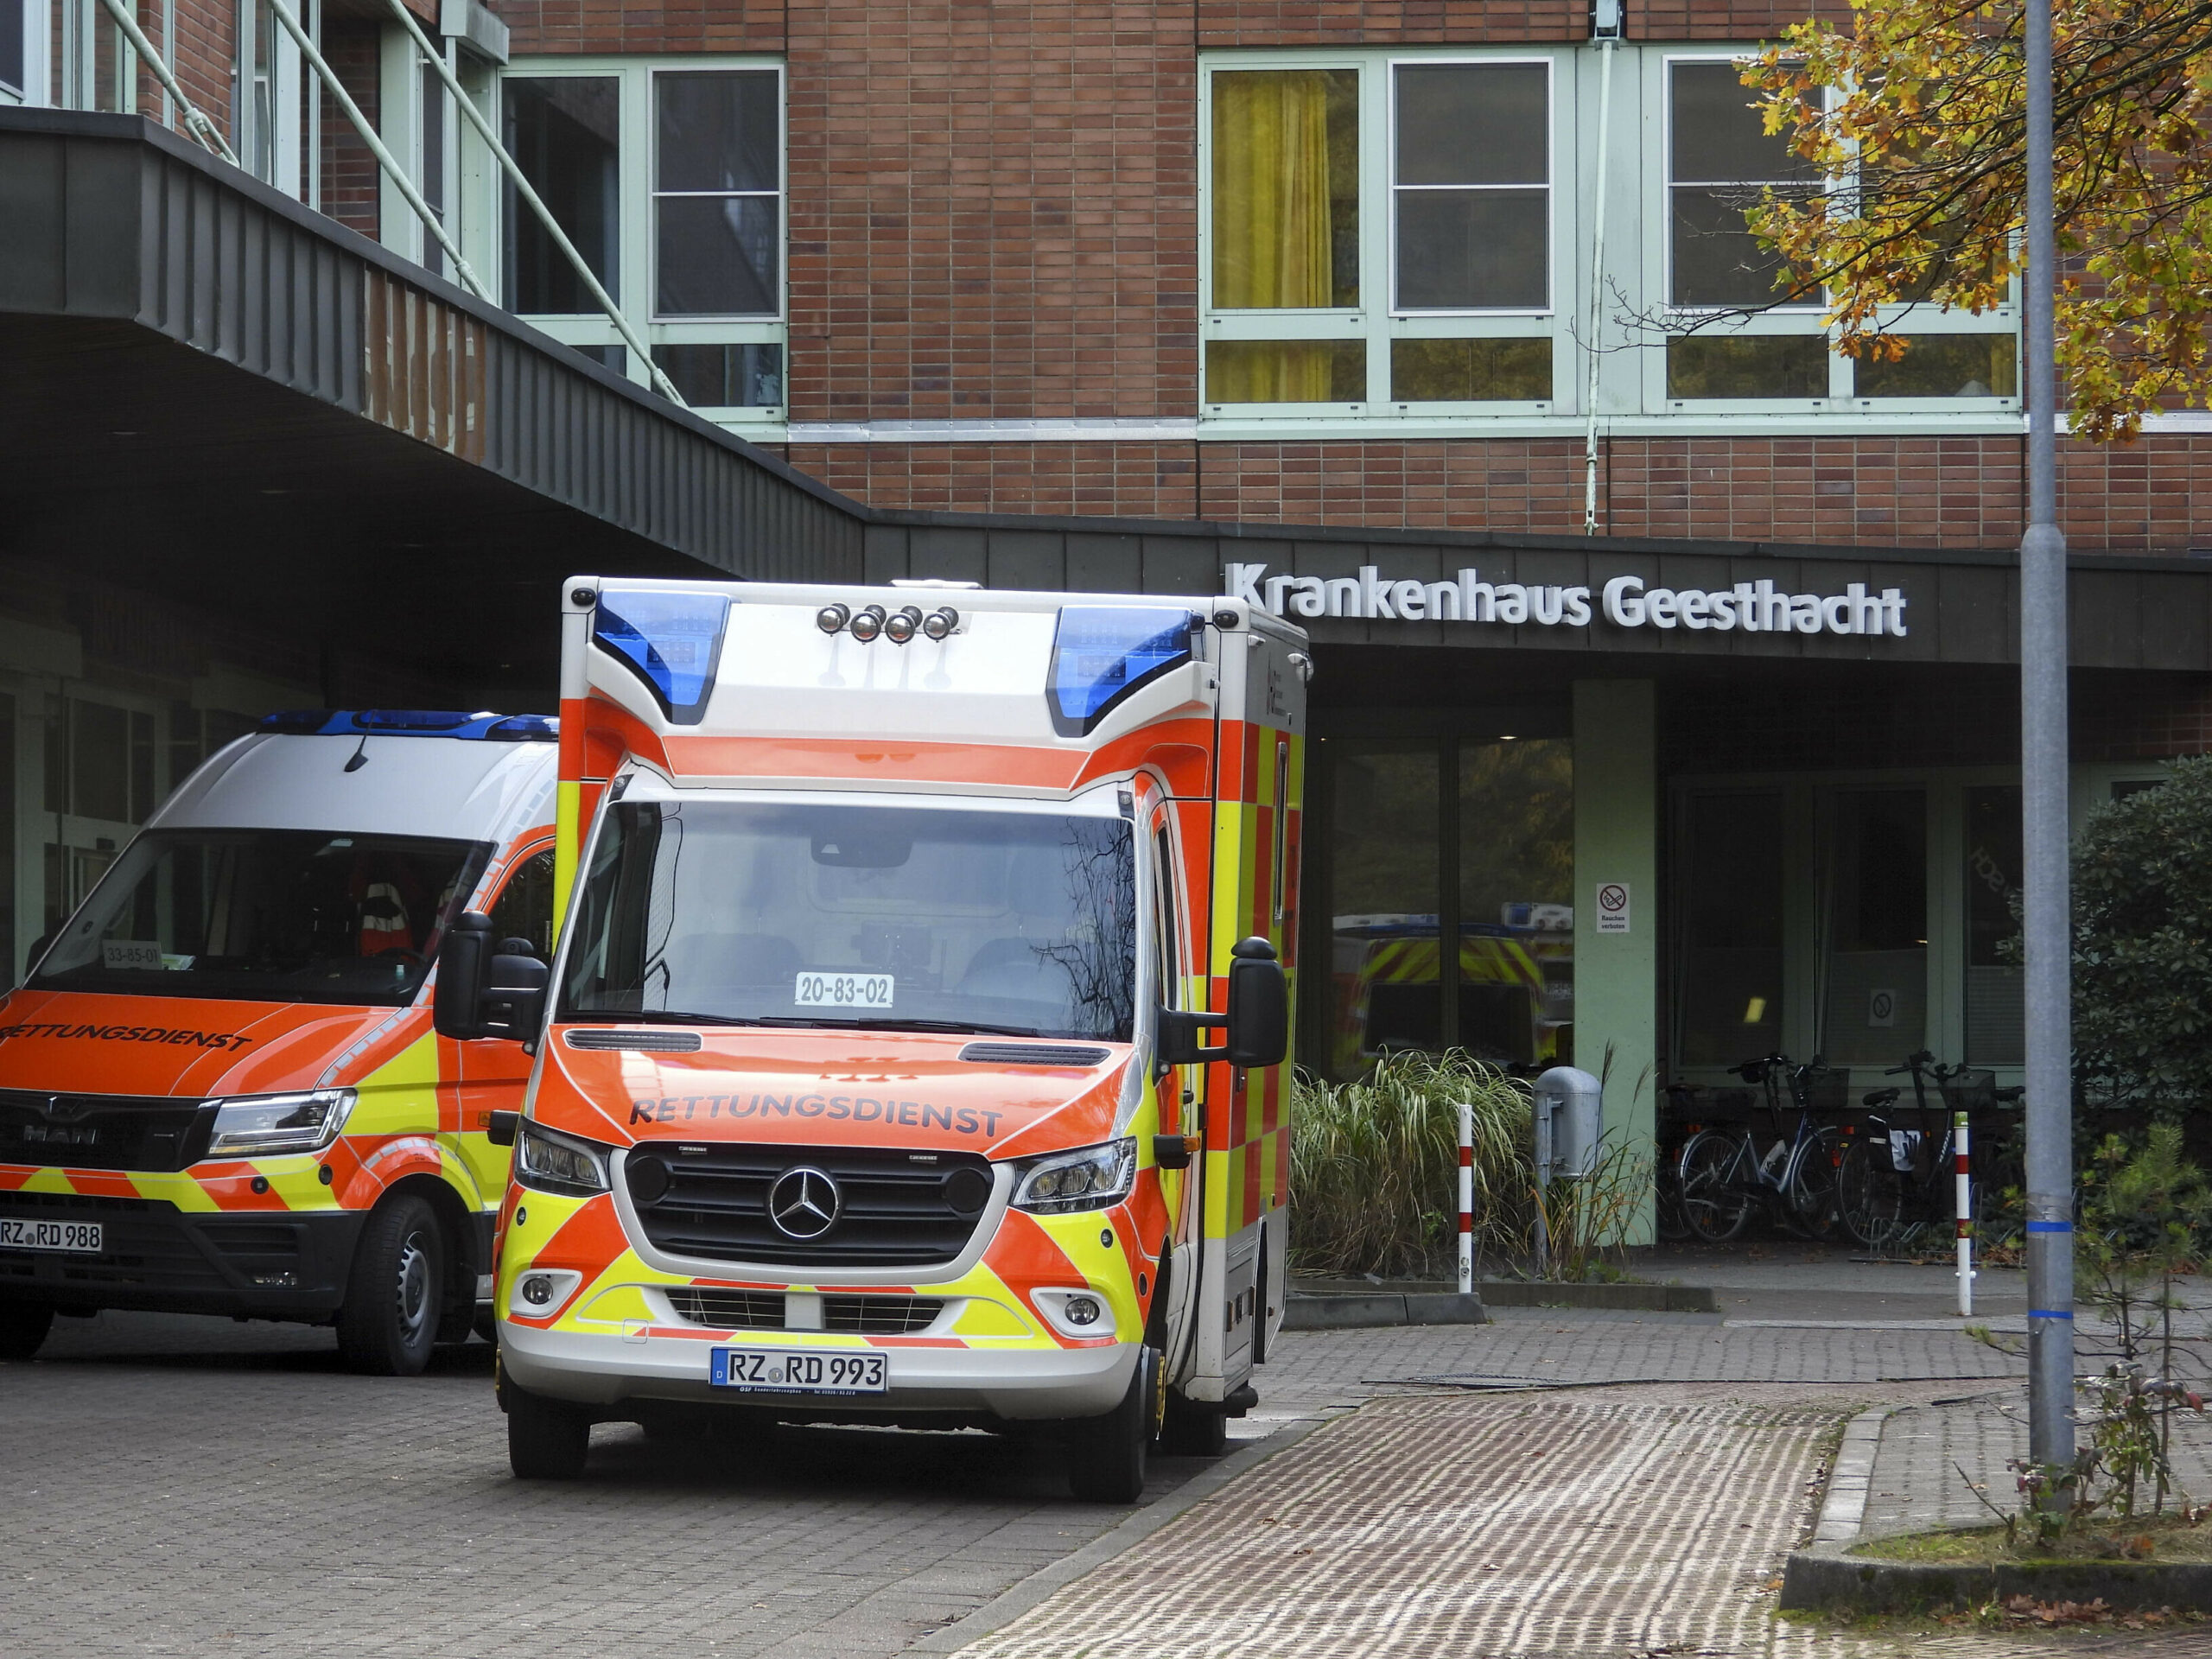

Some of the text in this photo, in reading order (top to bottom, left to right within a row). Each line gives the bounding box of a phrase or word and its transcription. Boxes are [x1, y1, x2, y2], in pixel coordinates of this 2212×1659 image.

[1224, 562, 1908, 637] Krankenhaus Geesthacht
[107, 947, 157, 963] 33-85-01
[801, 976, 887, 1003] 20-83-02
[0, 1024, 252, 1052] RETTUNGSDIENST
[629, 1094, 1003, 1138] RETTUNGSDIENST
[23, 1125, 98, 1145] MAN
[1, 1222, 100, 1248] RZ RD 988
[729, 1354, 882, 1385] RZ RD 993
